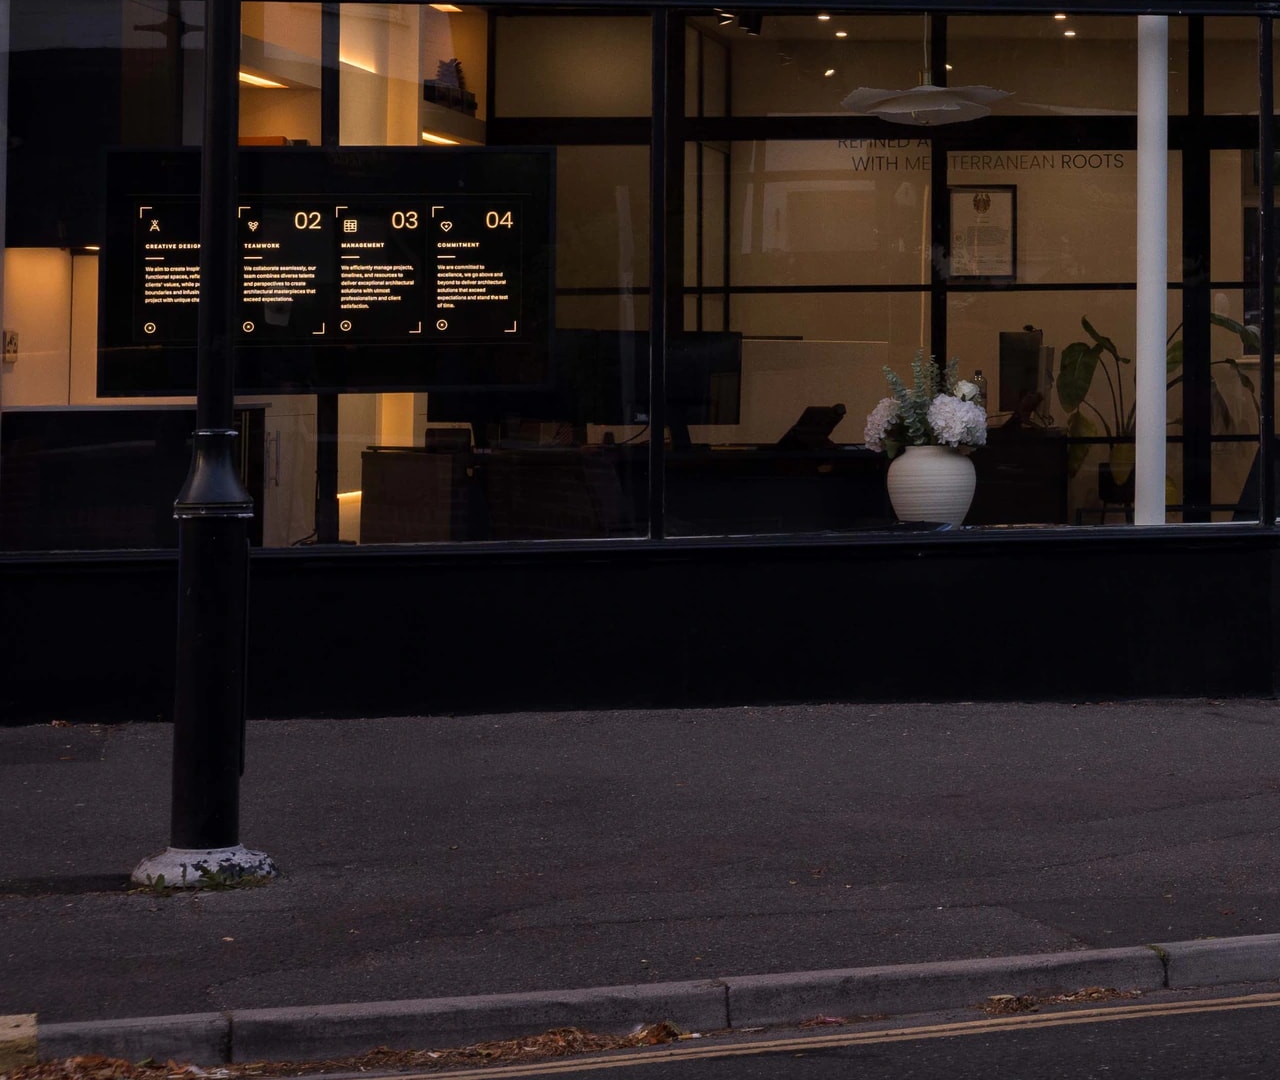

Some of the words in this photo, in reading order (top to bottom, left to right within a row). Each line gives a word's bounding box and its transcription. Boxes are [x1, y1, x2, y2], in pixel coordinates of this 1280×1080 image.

[852, 156, 898, 171] WITH
[1061, 154, 1124, 169] ROOTS
[294, 211, 322, 230] 02
[391, 211, 418, 229] 03
[486, 211, 513, 229] 04
